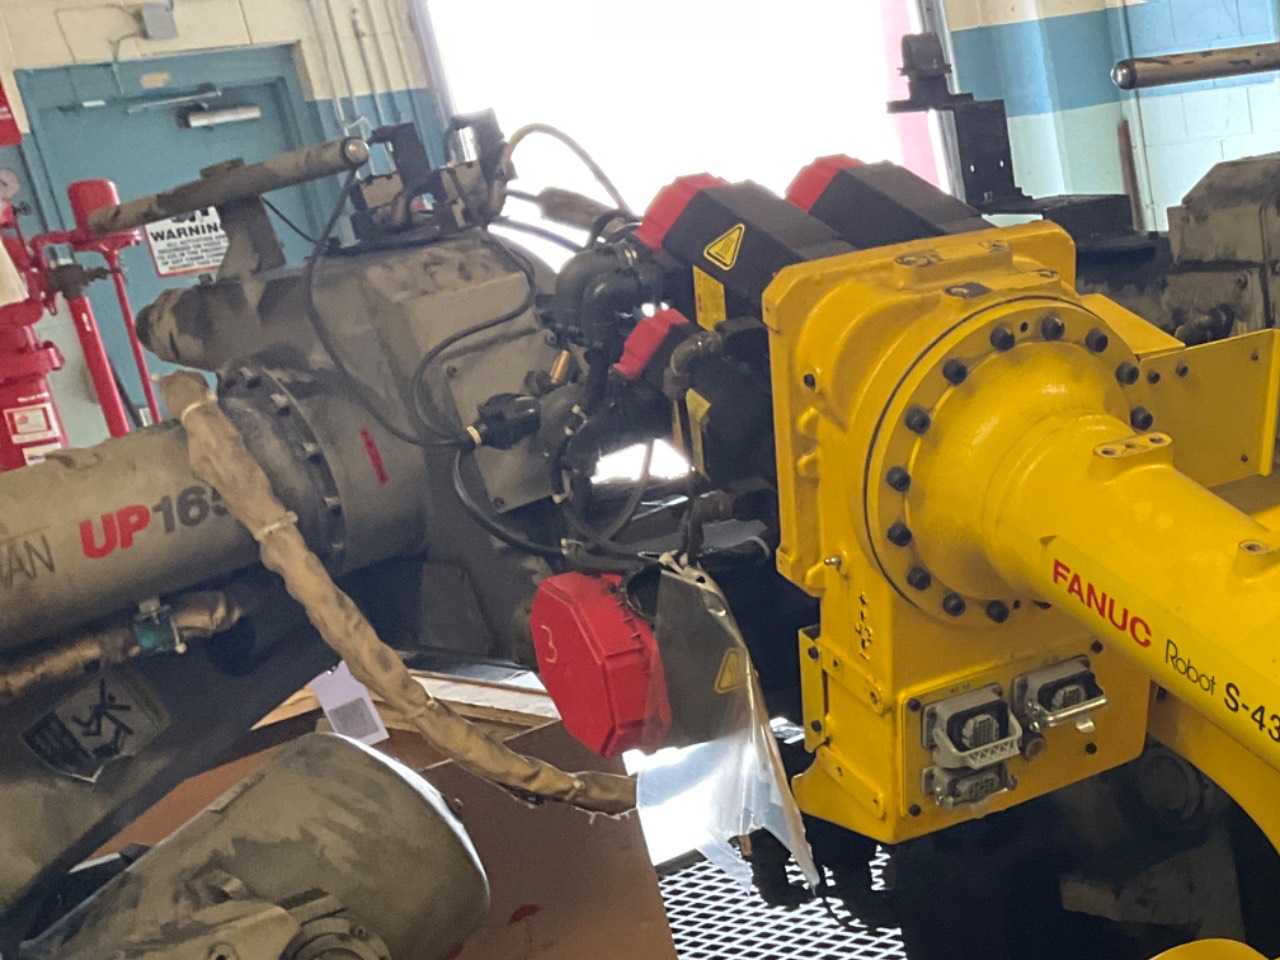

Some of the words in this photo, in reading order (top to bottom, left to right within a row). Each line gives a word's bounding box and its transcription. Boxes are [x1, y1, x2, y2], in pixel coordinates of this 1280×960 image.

[150, 222, 220, 243] WARNIN
[1053, 558, 1151, 648] FANUC
[1165, 639, 1216, 696] Robot
